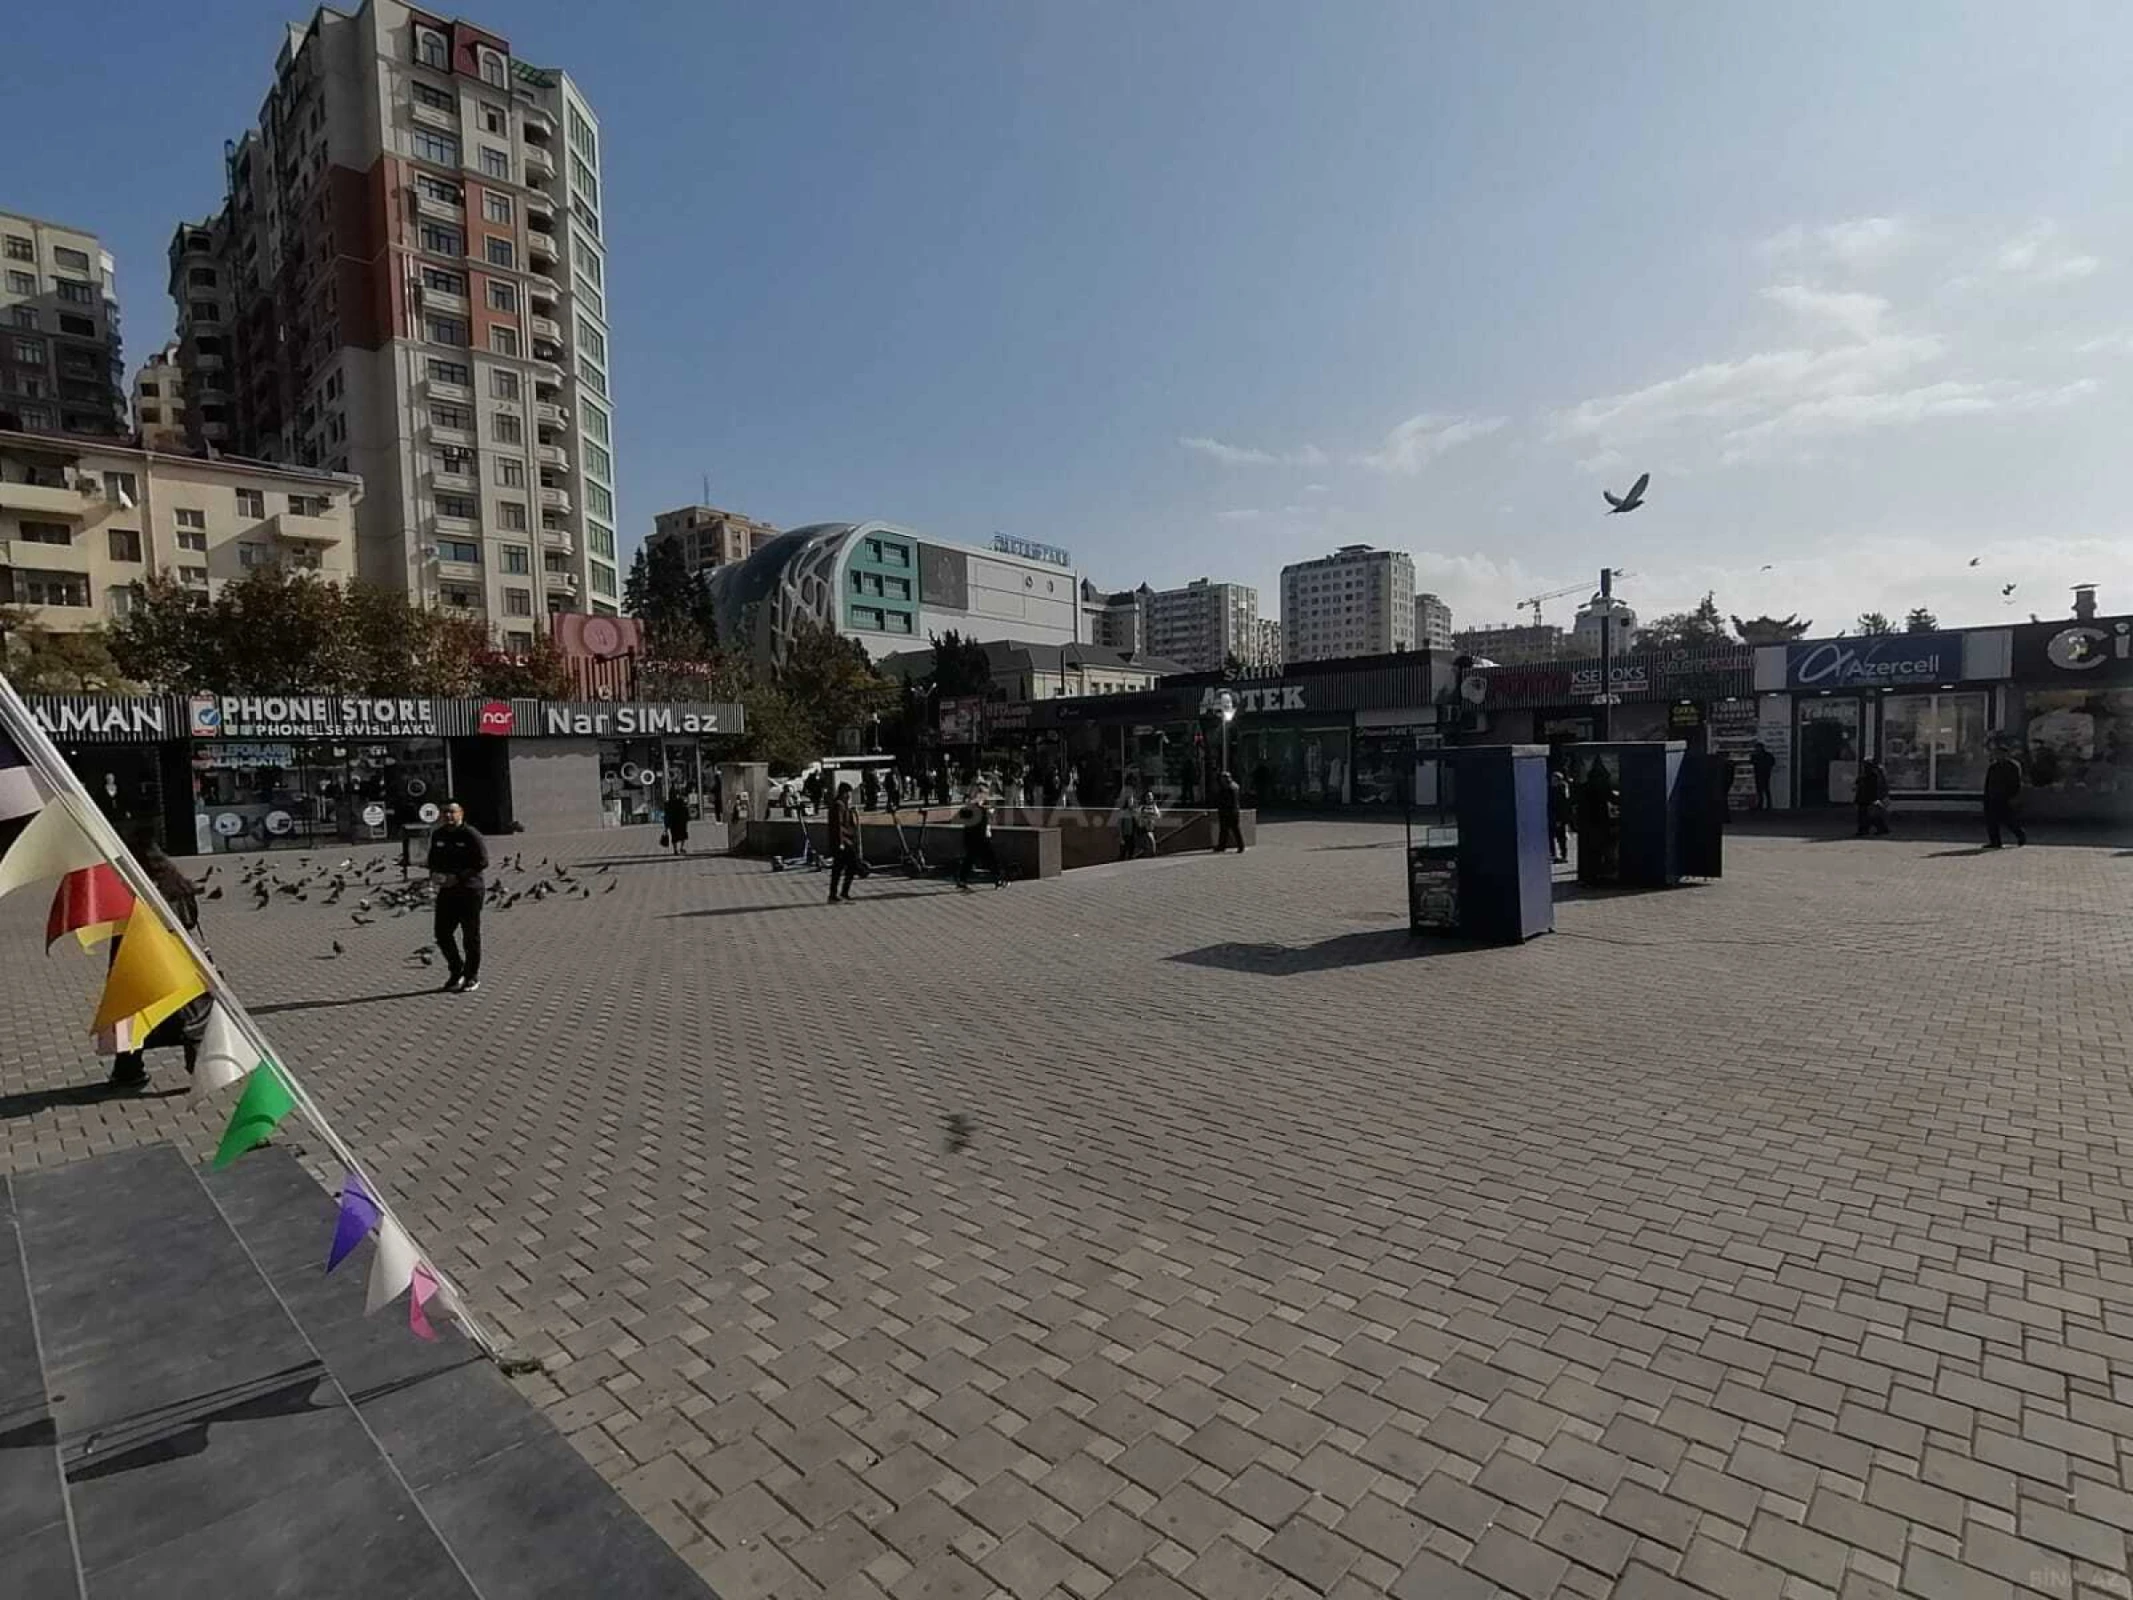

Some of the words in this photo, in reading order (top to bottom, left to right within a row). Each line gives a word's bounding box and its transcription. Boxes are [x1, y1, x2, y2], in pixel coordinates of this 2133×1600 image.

[1571, 667, 1645, 683] KSEOKS
[1846, 653, 1940, 676] Azercell
[221, 696, 326, 721] PHONE
[341, 697, 431, 722] STORE
[482, 711, 513, 725] nar
[548, 708, 608, 735] Nar
[617, 708, 718, 735] SIM.az
